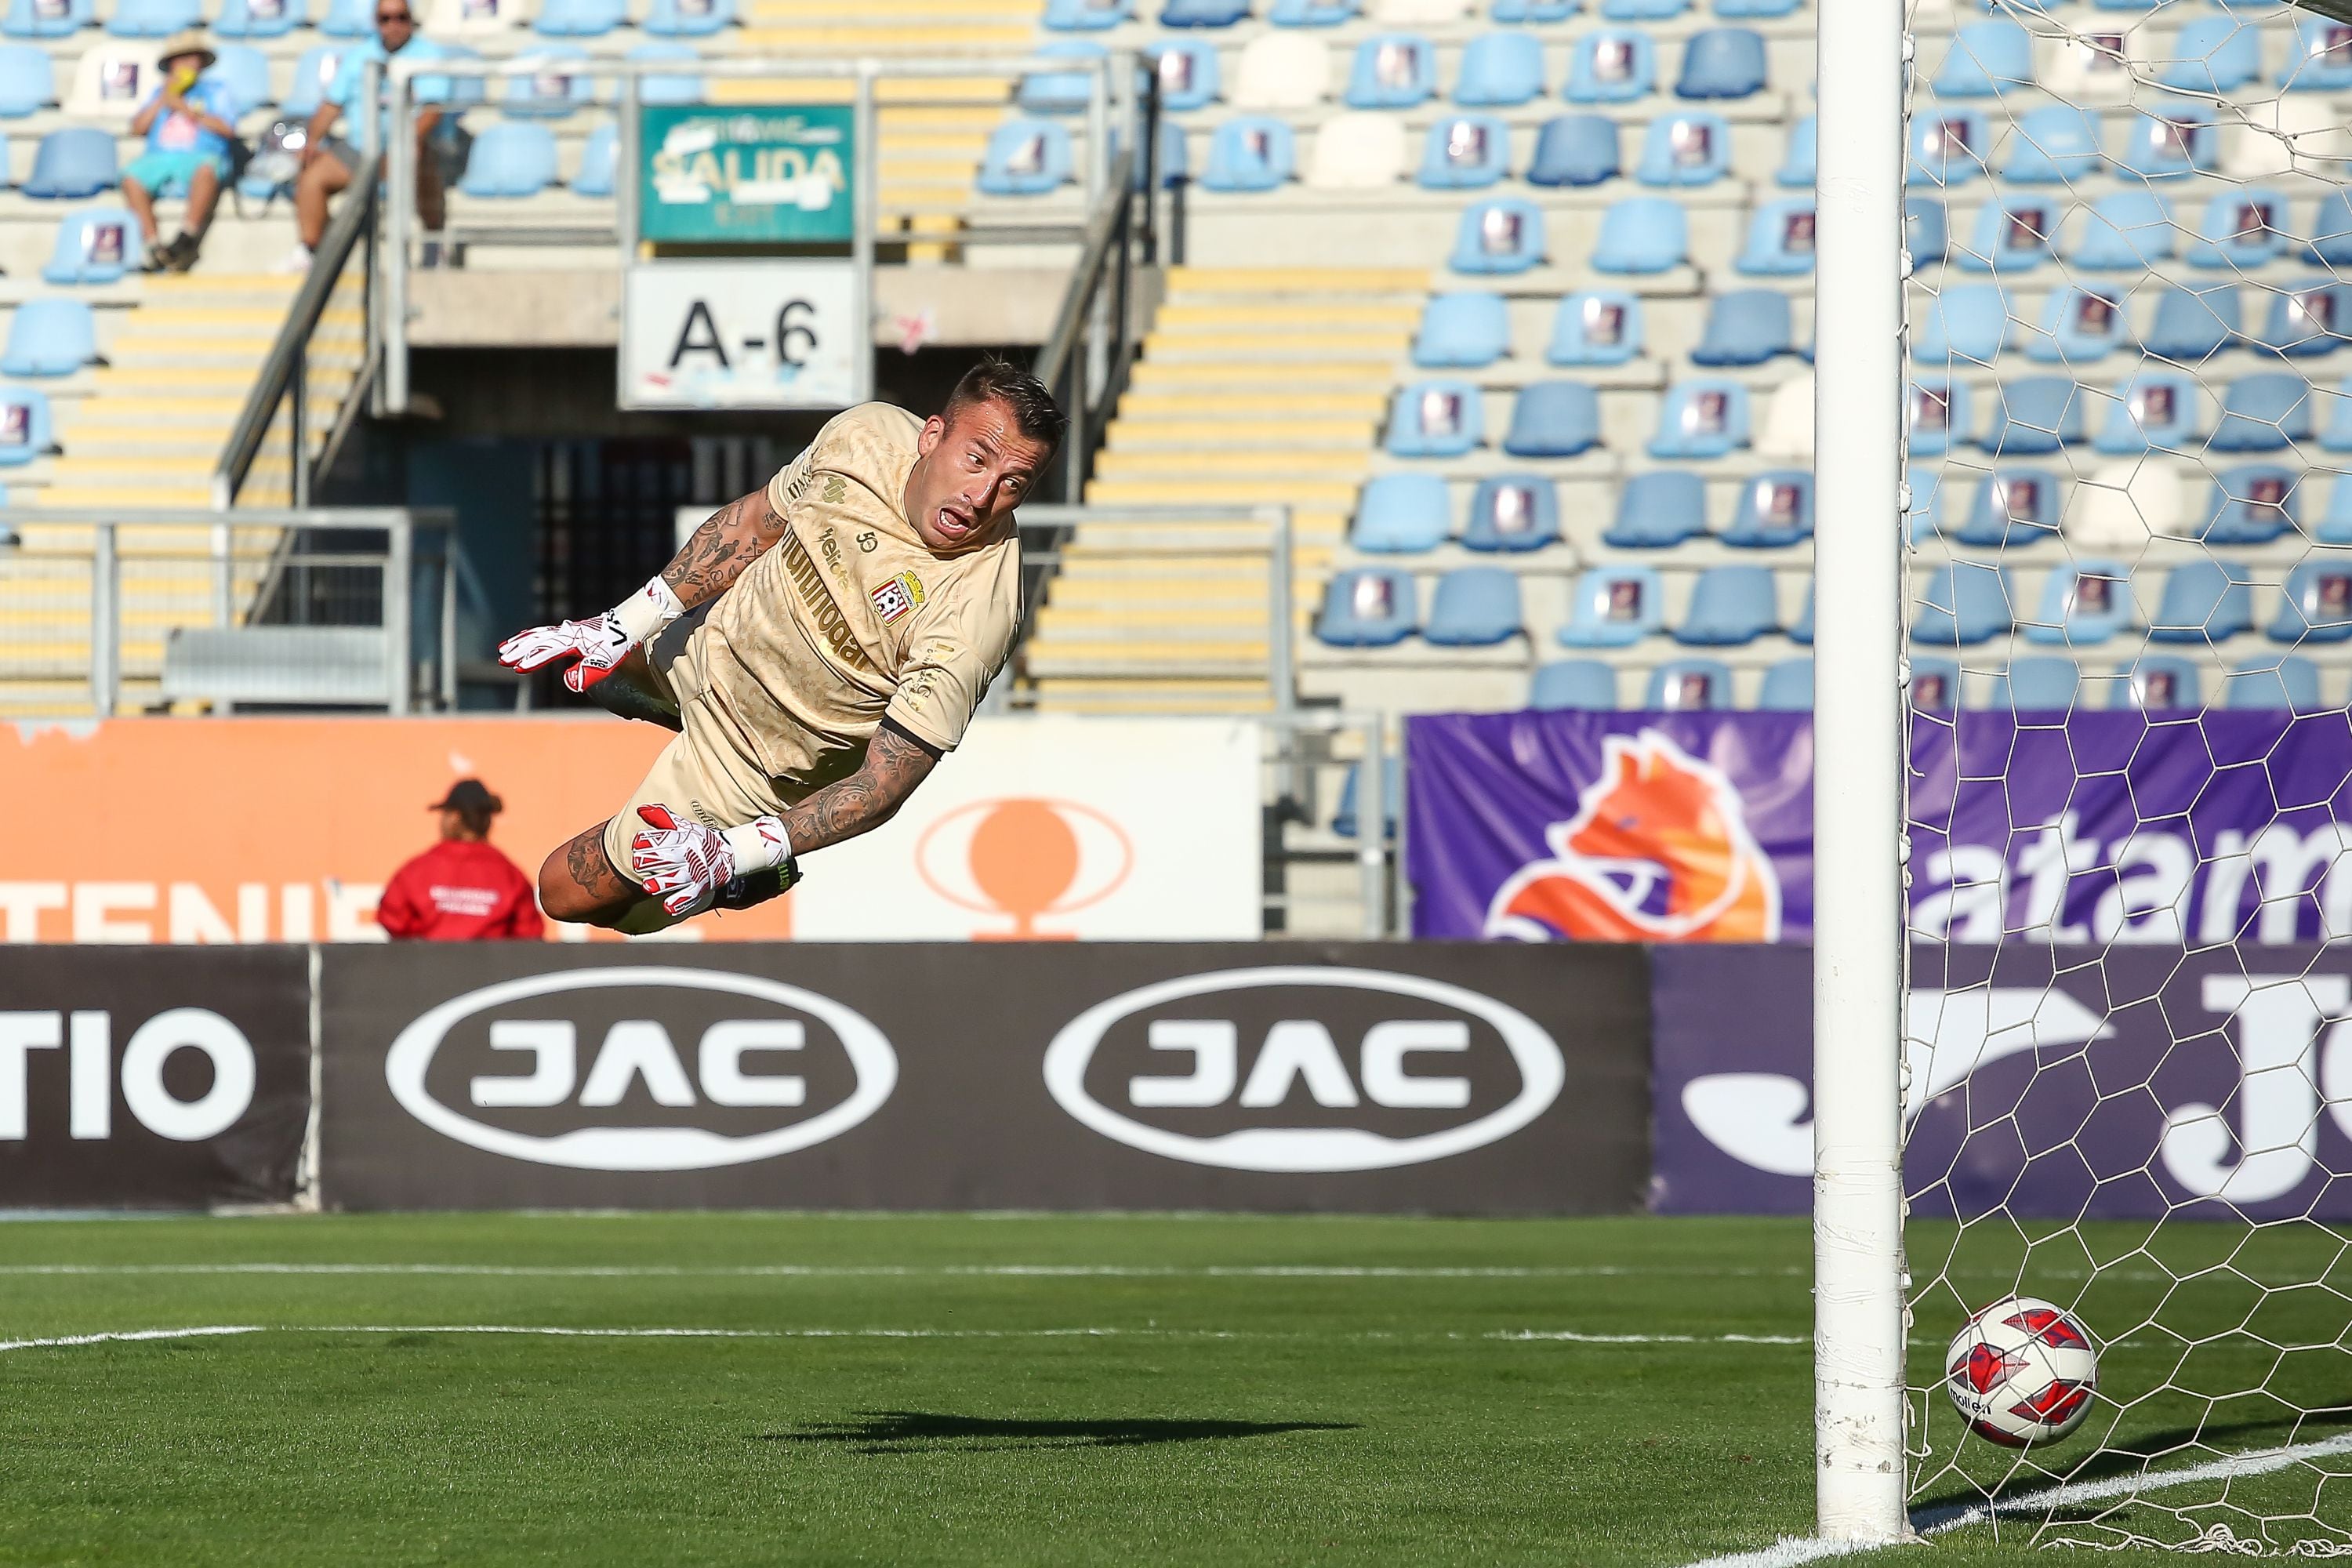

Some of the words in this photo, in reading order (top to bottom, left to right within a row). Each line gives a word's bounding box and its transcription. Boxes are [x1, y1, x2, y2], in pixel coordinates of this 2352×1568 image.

[652, 147, 846, 196] SALIDA
[670, 300, 817, 368] A-6
[0, 1007, 256, 1141] TIO
[470, 1019, 806, 1108] JAC
[1129, 1019, 1471, 1108] JAC
[2161, 974, 2352, 1203] J
